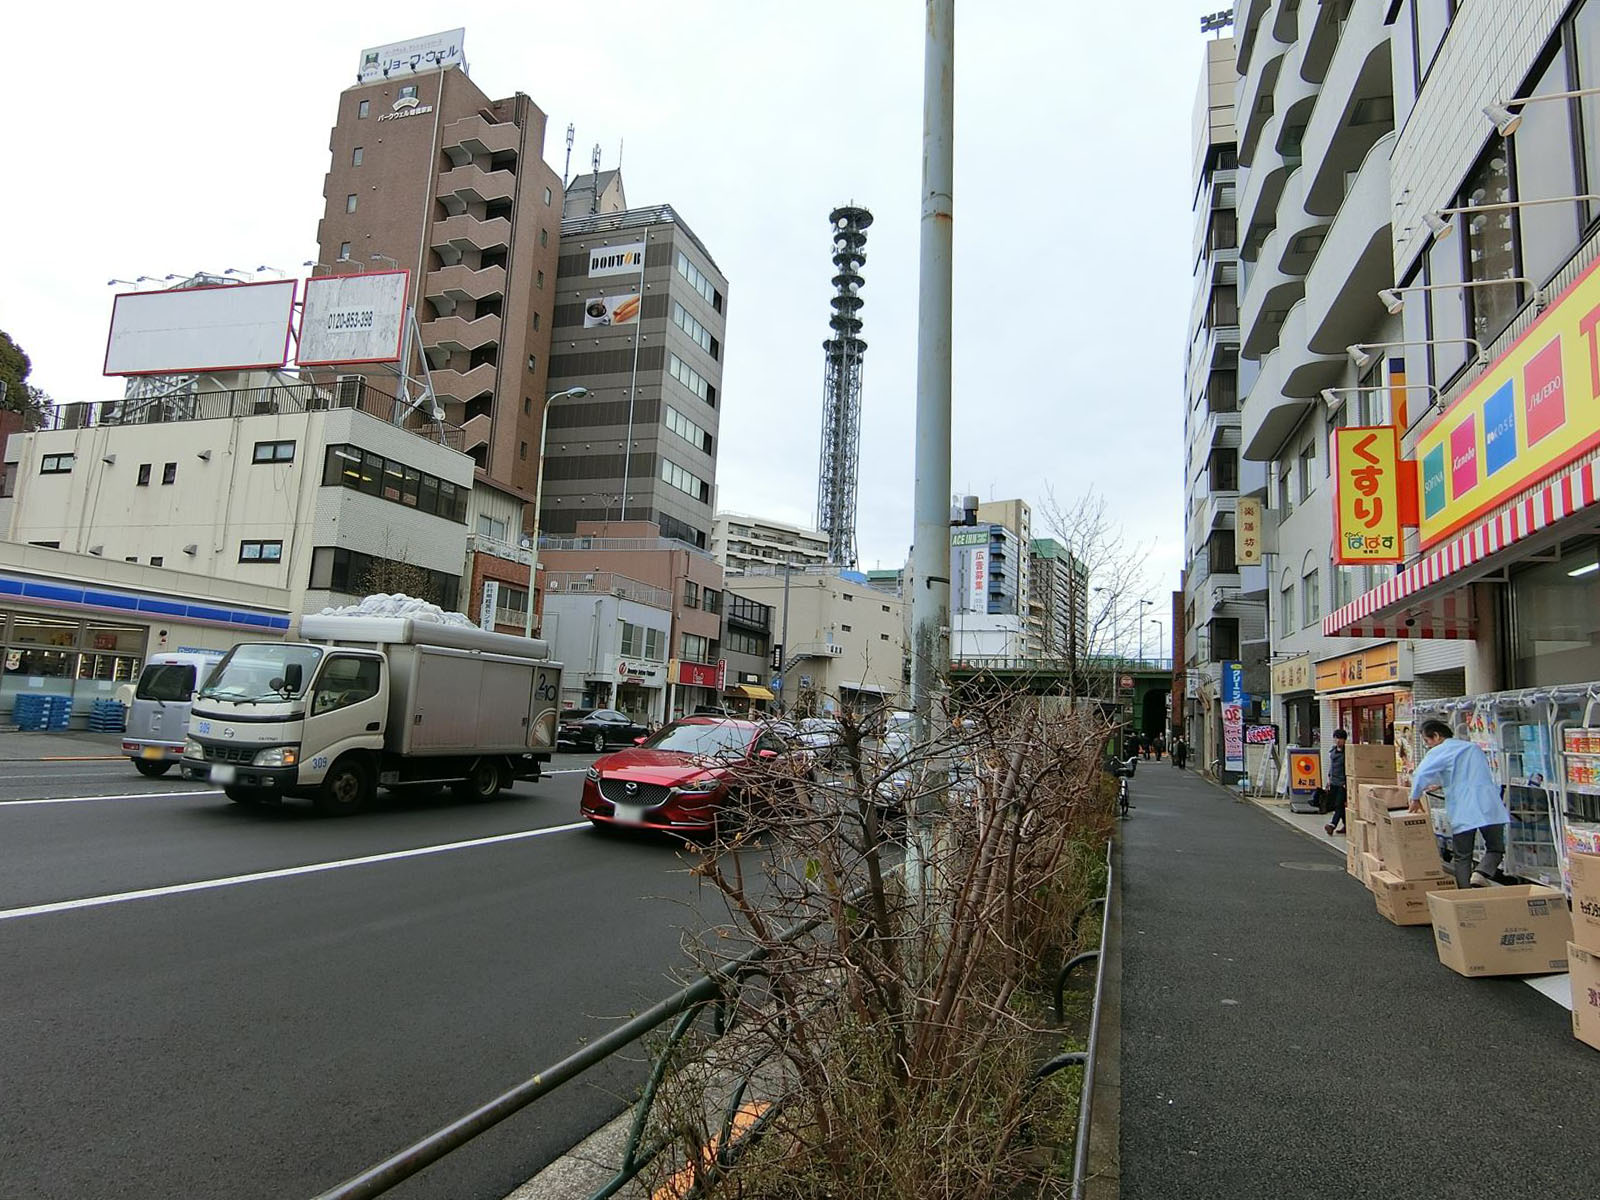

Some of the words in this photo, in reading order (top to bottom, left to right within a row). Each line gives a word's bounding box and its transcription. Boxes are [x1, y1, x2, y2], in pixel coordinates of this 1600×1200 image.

[592, 251, 641, 270] DOUTOR
[1527, 375, 1561, 412] SHISEIDO
[1351, 433, 1383, 529] くすり
[952, 534, 965, 545] ACE
[312, 757, 327, 769] 309
